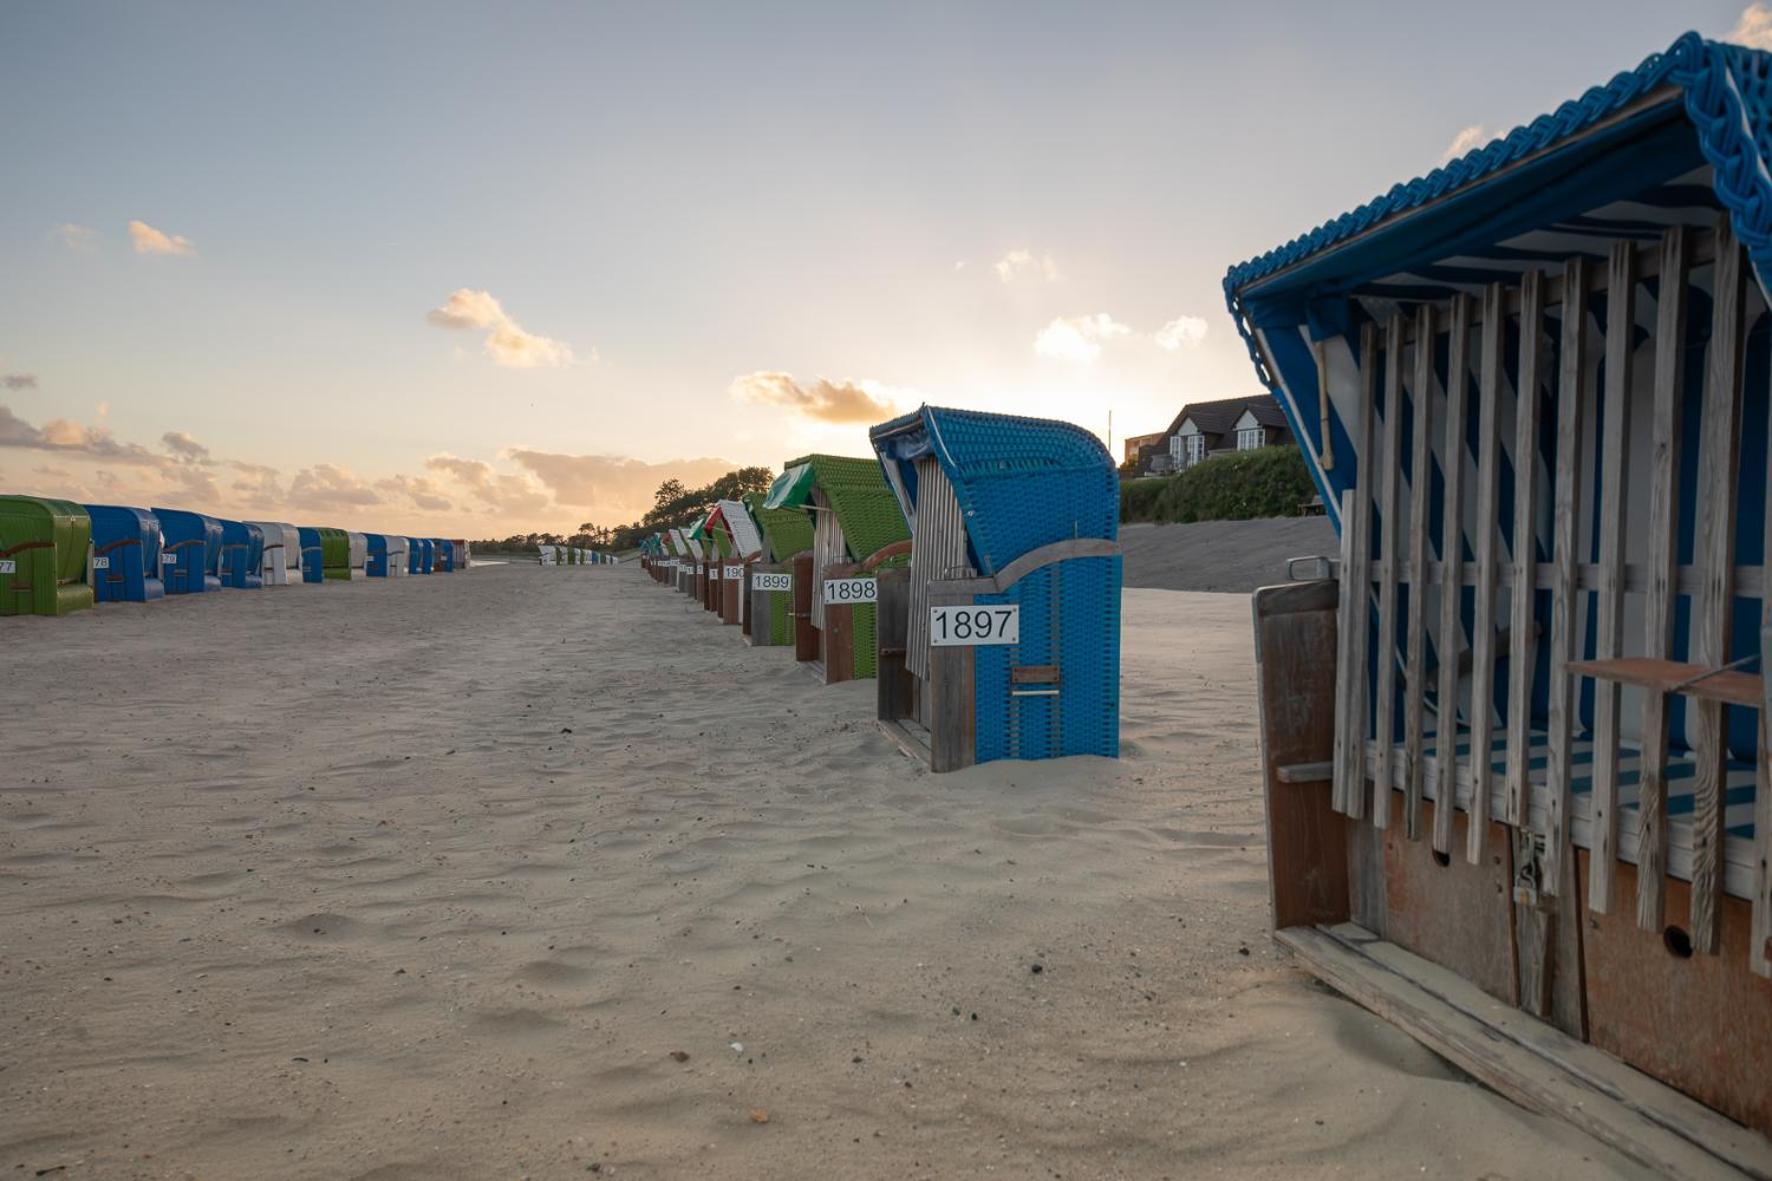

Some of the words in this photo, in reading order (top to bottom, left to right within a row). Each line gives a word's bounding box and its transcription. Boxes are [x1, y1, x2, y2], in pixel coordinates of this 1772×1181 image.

[95, 559, 107, 567] 78
[756, 575, 789, 588] 1899
[828, 581, 875, 600] 1898
[936, 610, 1012, 639] 1897
